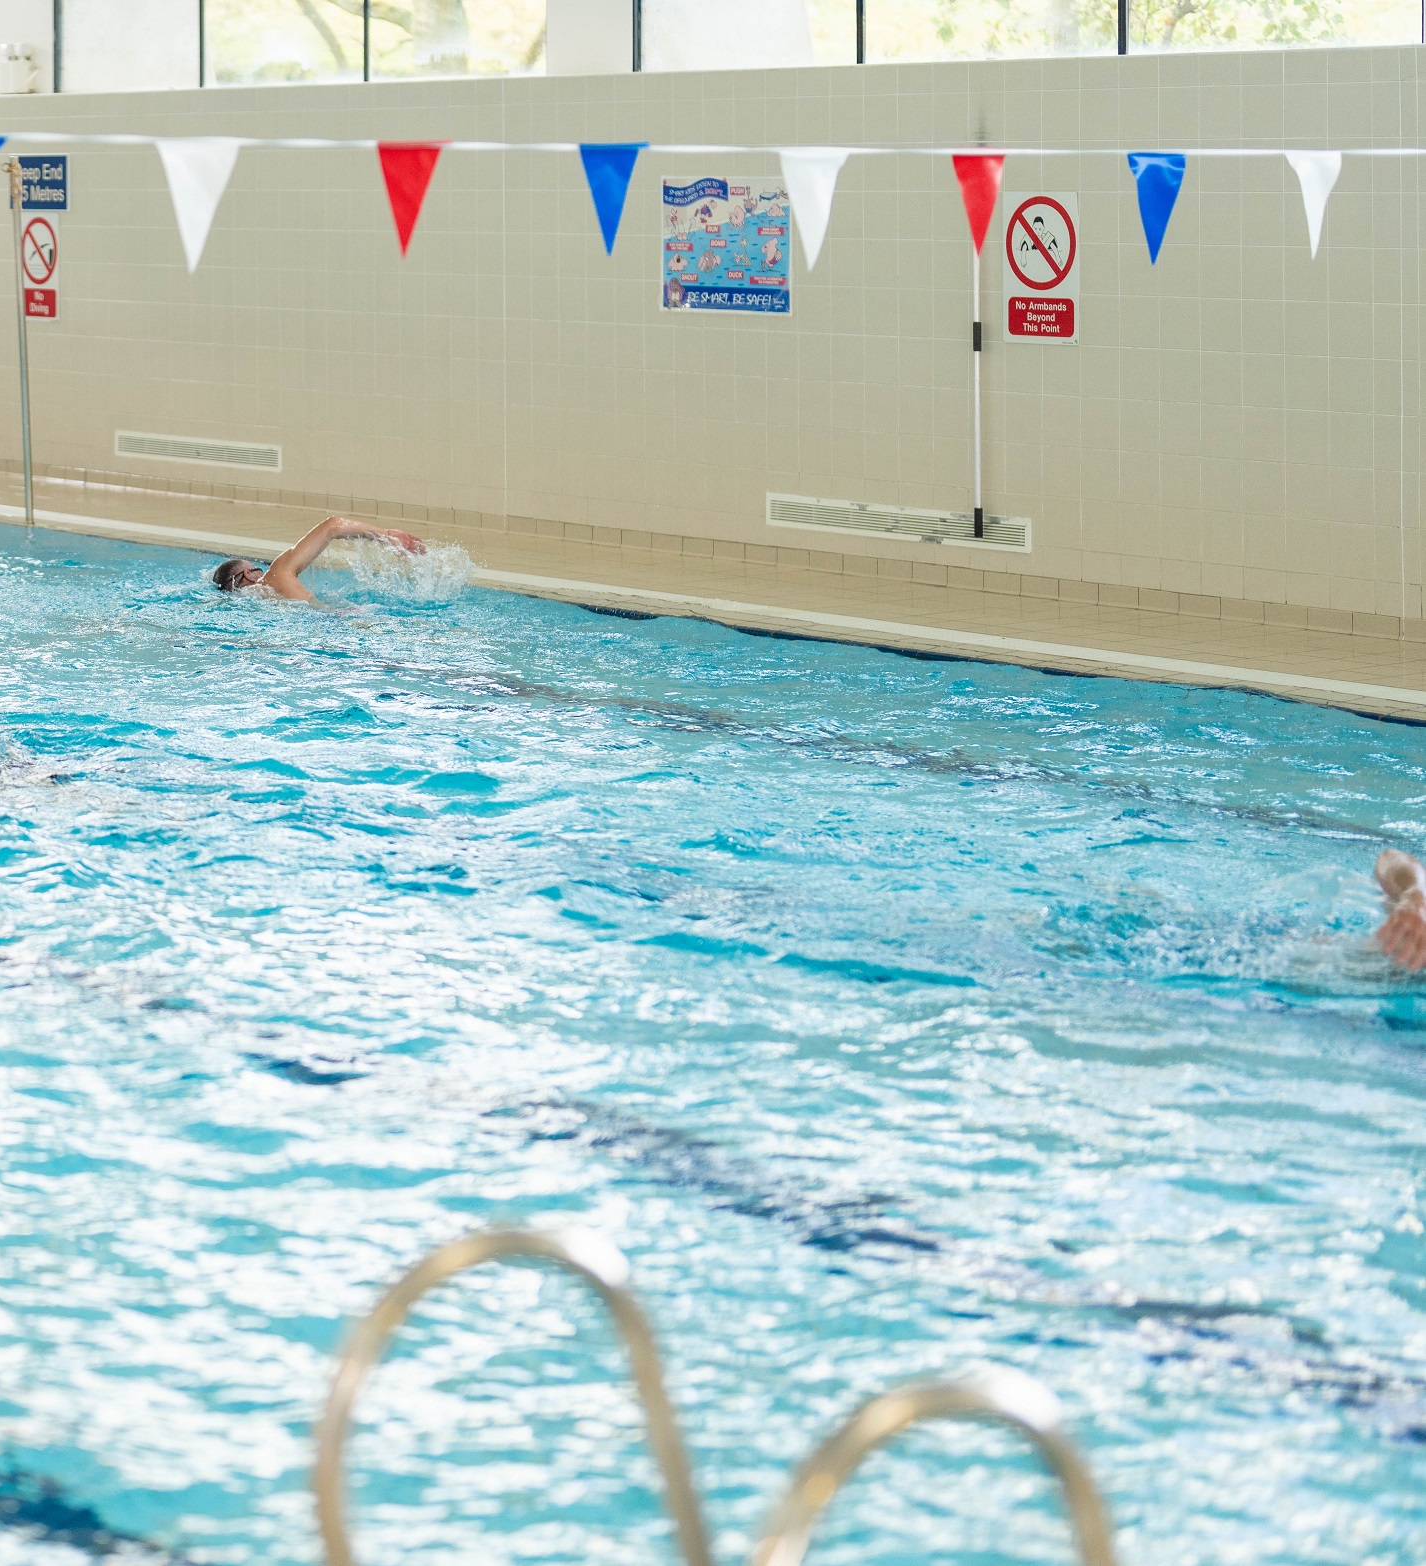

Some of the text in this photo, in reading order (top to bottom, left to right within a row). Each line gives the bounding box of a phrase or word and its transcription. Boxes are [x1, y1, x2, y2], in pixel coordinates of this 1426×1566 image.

[21, 163, 63, 184] eep End
[29, 185, 65, 202] Metres
[731, 187, 744, 195] PUSH
[728, 271, 743, 279] DUCK
[34, 291, 44, 301] No
[687, 292, 700, 302] BE
[732, 293, 745, 304] BE
[746, 294, 772, 306] SAFE!
[29, 302, 50, 316] Diving
[1015, 301, 1067, 312] No Armbands
[1027, 312, 1056, 323] Beyond
[1023, 322, 1060, 333] This Point
